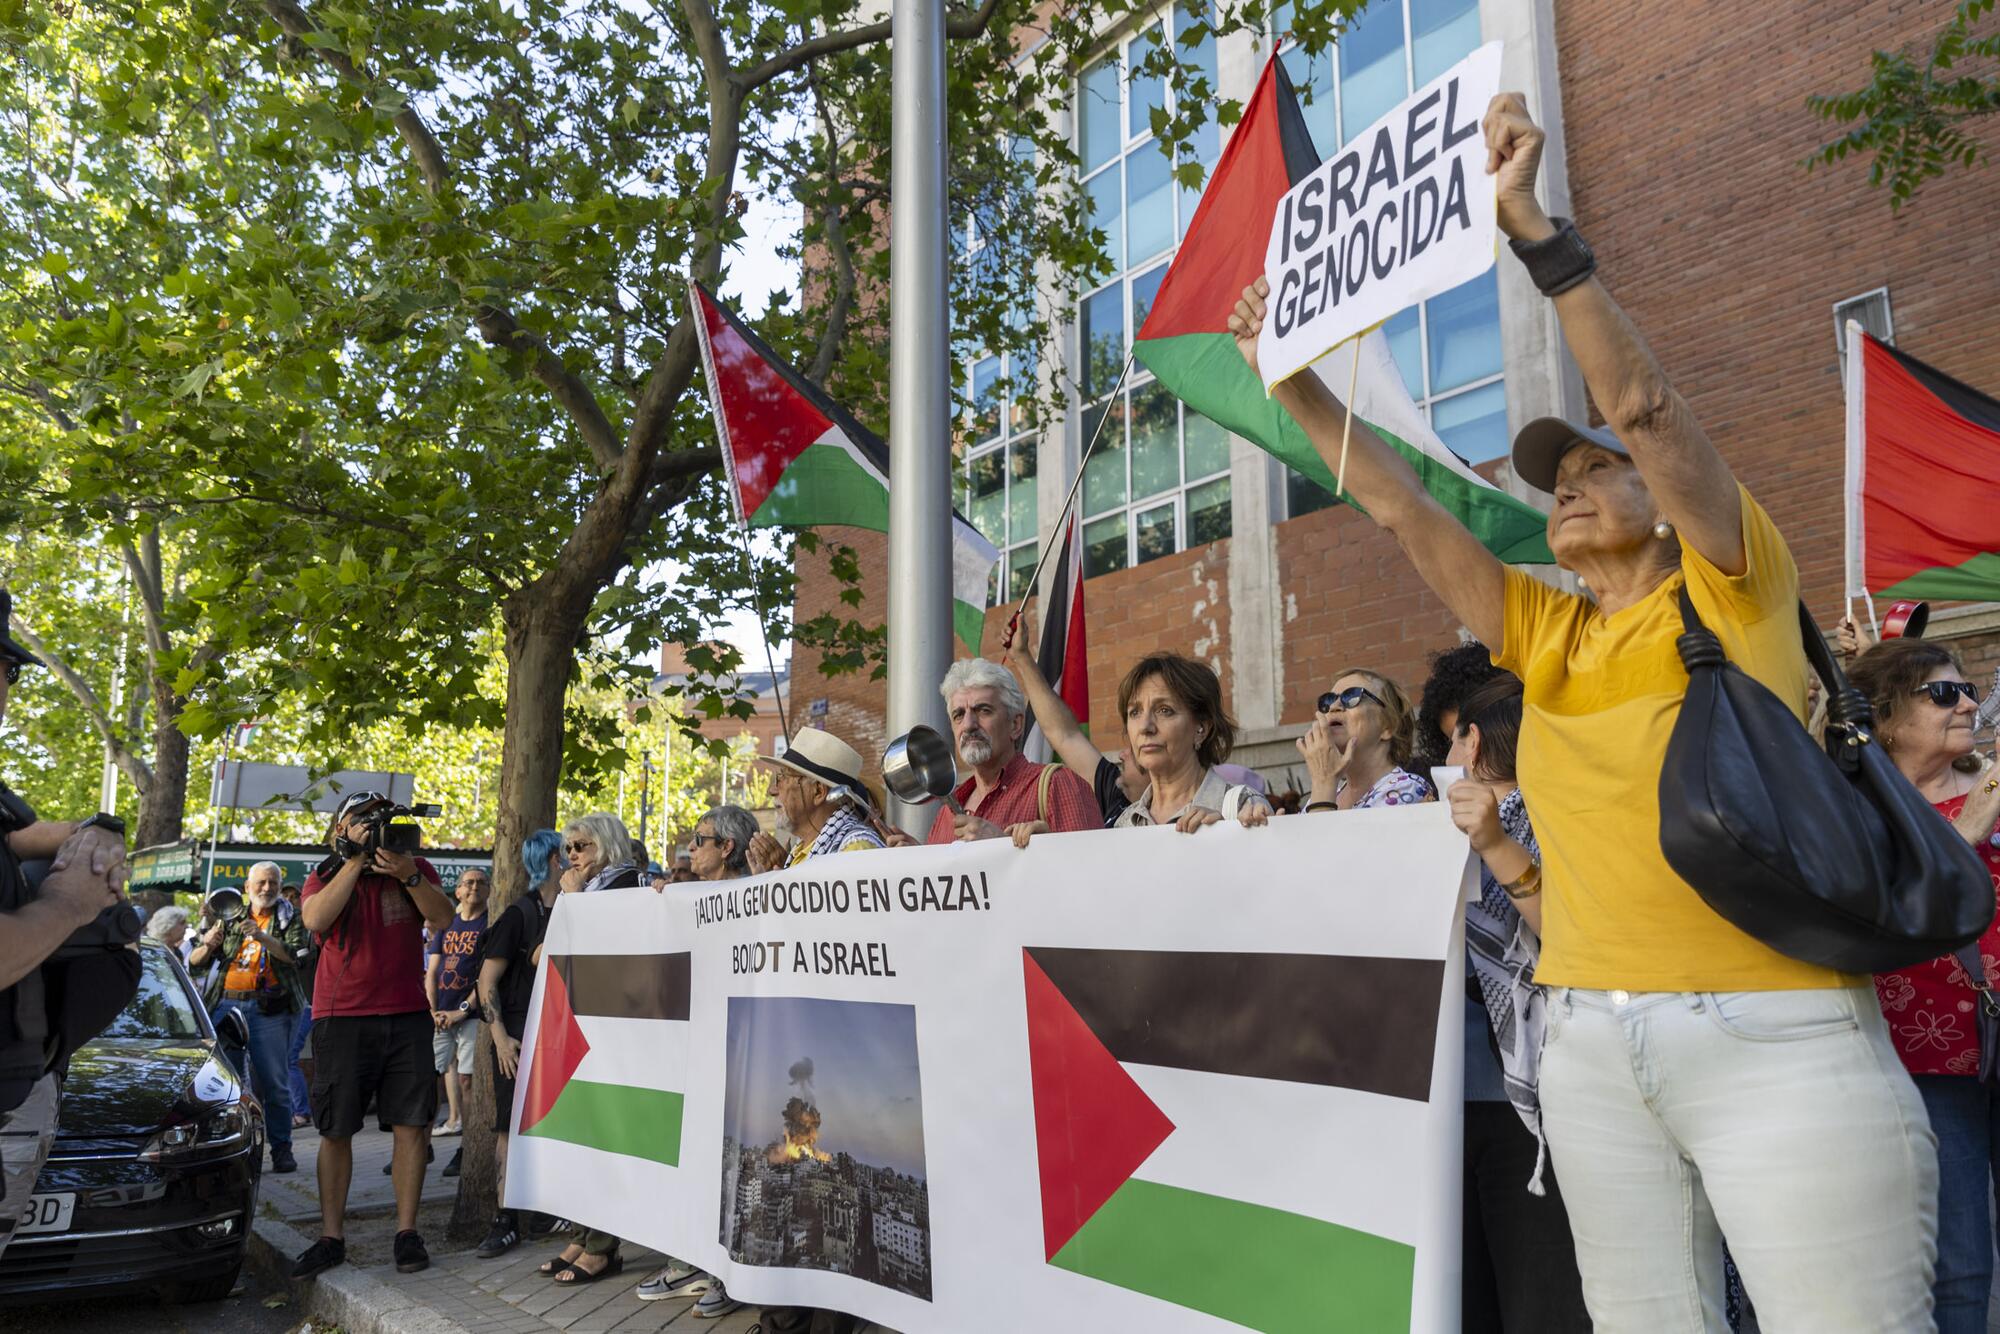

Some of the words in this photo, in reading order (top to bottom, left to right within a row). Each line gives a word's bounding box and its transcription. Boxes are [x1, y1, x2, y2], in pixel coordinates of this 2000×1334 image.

[1281, 76, 1478, 266] ISRAEL
[1274, 155, 1471, 340] GENOCIDA
[695, 893, 723, 929] ¡ALTO
[727, 890, 741, 920] AL
[743, 879, 849, 918] GENOCIDIO
[857, 878, 891, 913] EN
[898, 871, 991, 912] GAZA!
[793, 941, 808, 973] A
[813, 941, 896, 977] ISRAEL
